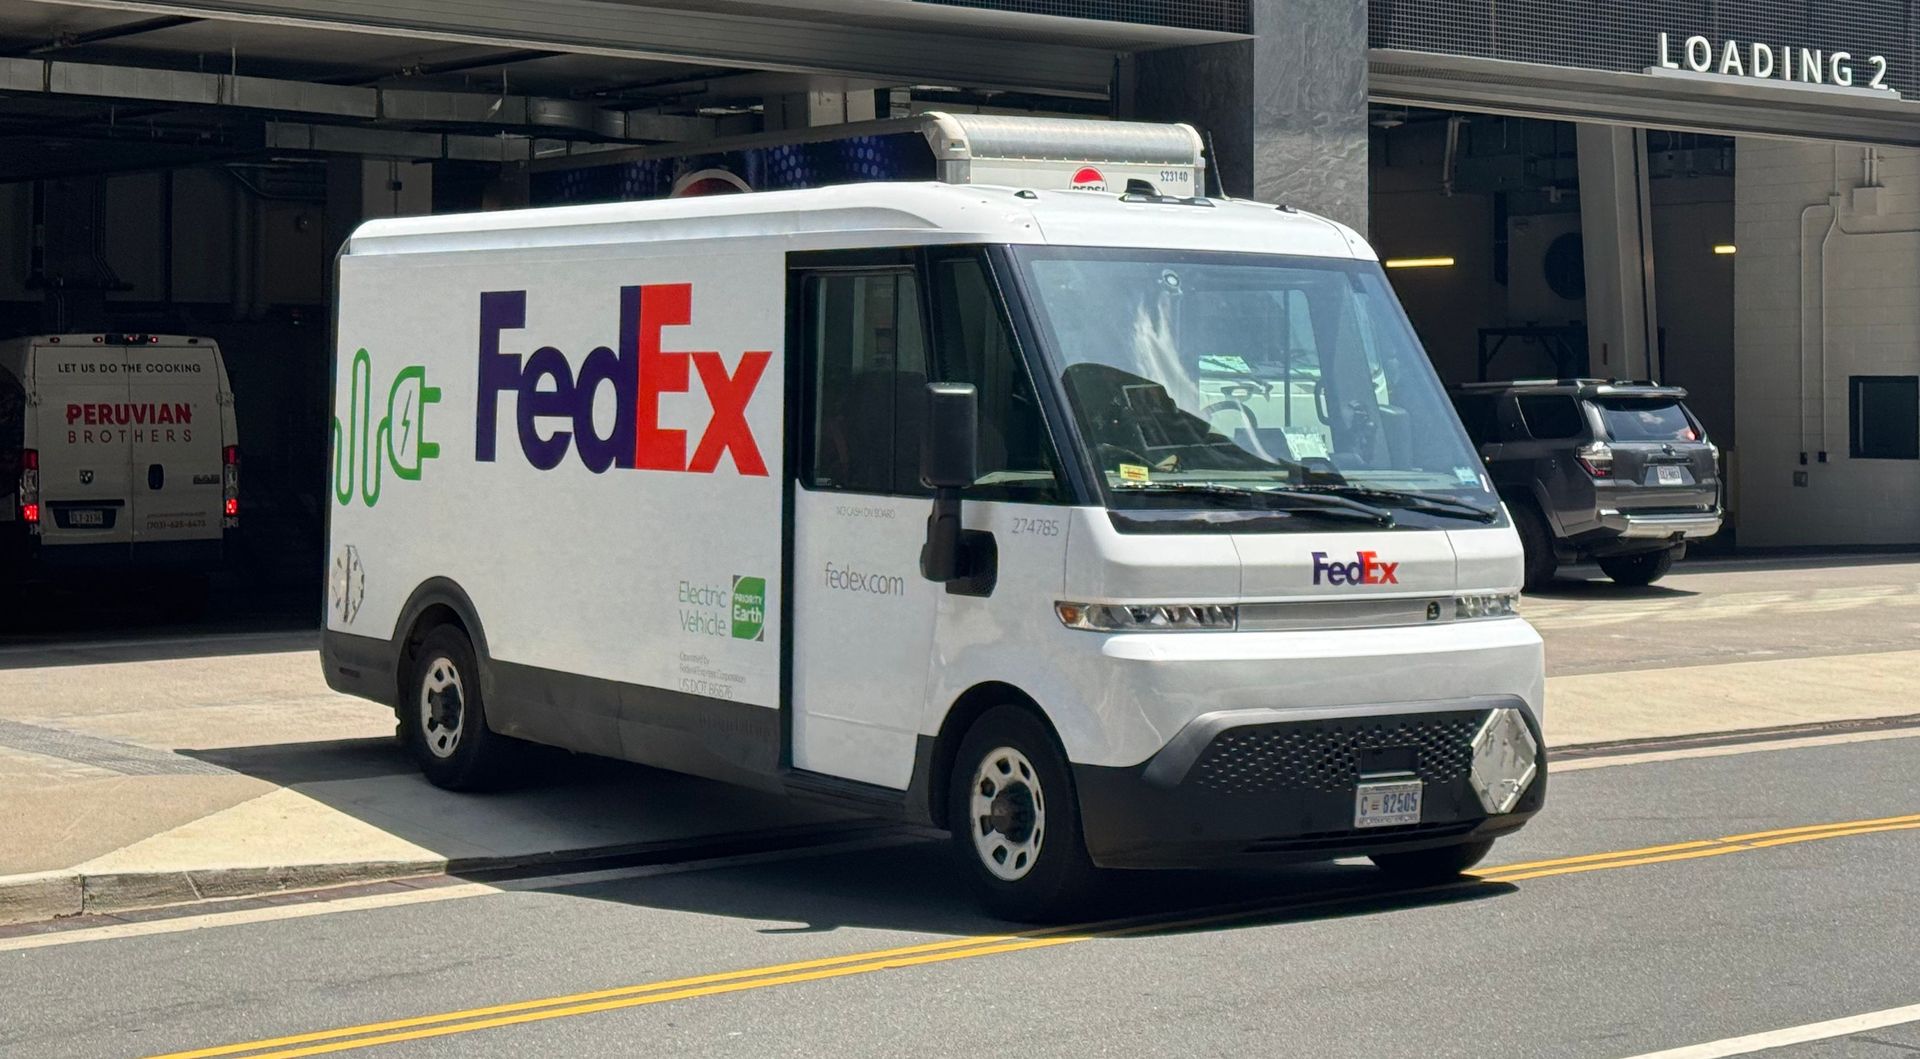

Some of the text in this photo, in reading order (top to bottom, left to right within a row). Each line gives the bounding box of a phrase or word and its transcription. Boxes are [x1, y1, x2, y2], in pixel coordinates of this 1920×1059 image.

[1659, 32, 1888, 90] LOADING 2
[1161, 171, 1188, 182] S23140
[58, 363, 201, 374] LET US DO THE COOKING
[475, 283, 773, 477] FedEx
[66, 403, 193, 425] PERUVIAN
[68, 429, 193, 444] BROTHERS
[1011, 517, 1059, 537] 274785
[825, 561, 904, 596] fedex.com
[1311, 551, 1399, 586] FedEx
[679, 580, 727, 608] Electric
[679, 609, 726, 637] Vehicle
[734, 604, 762, 623] Earth
[1361, 792, 1418, 816] C 82505
